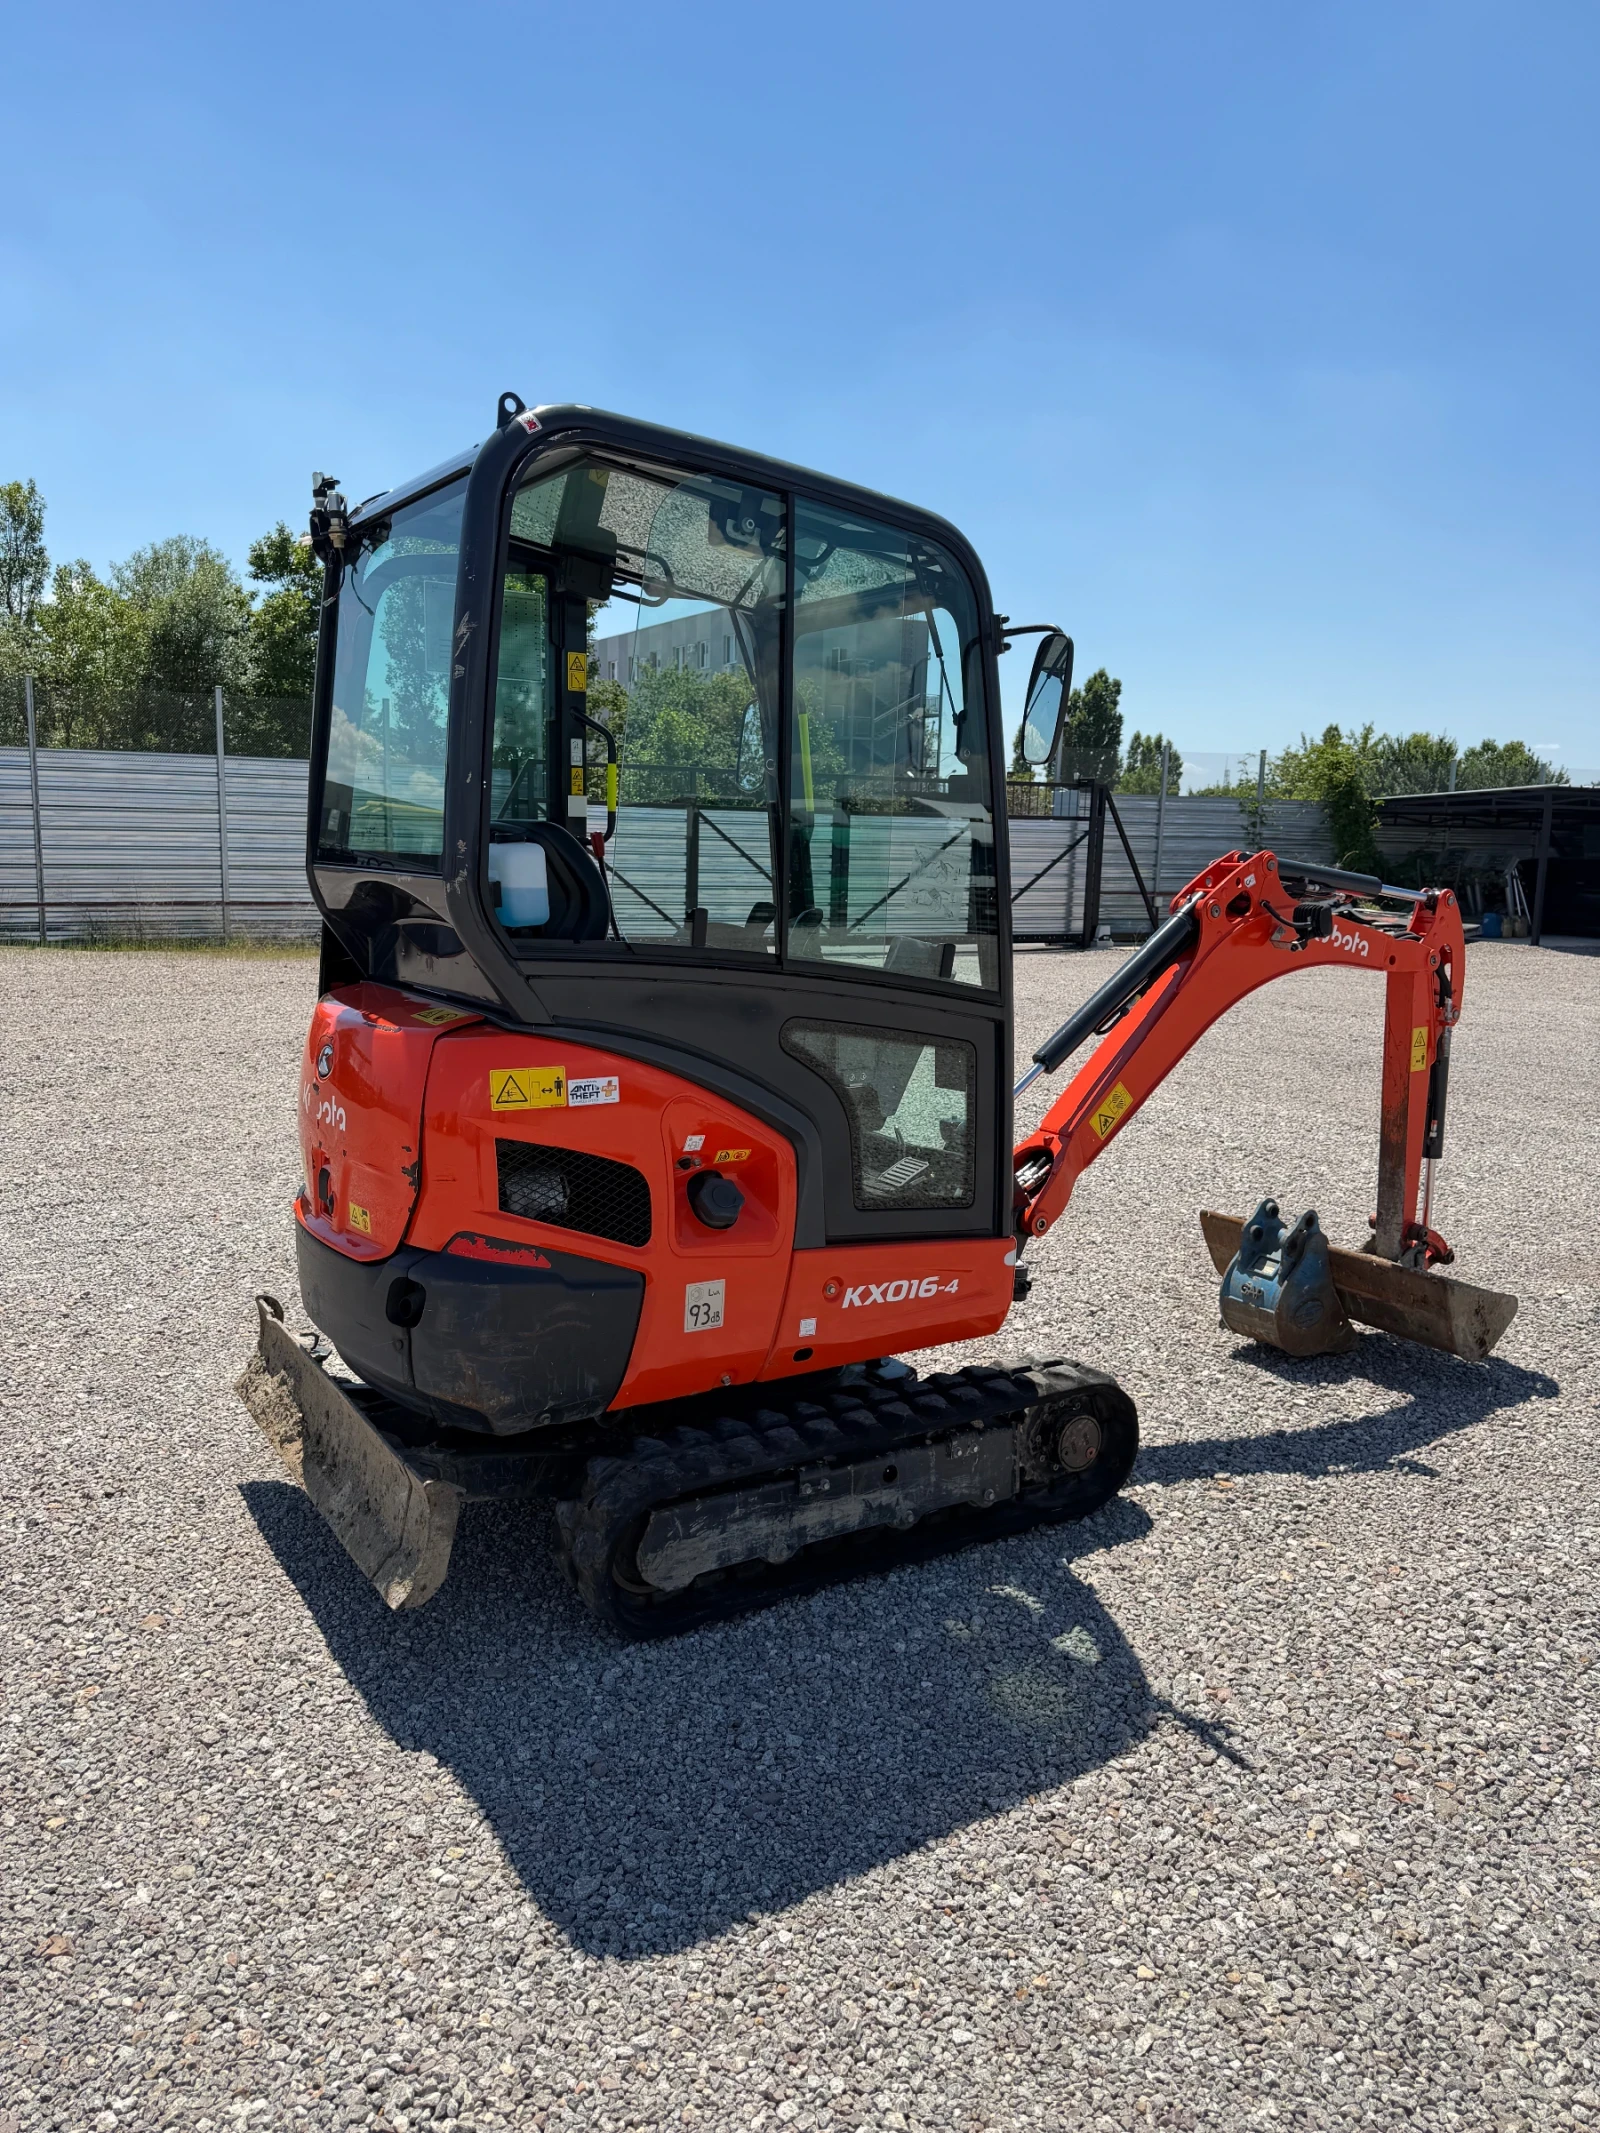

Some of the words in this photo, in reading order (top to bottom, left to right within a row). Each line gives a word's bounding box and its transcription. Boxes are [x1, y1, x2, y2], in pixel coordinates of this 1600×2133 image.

[1315, 924, 1369, 957] bota
[569, 1091, 601, 1101] THEFT
[841, 1275, 960, 1309] KX016-4
